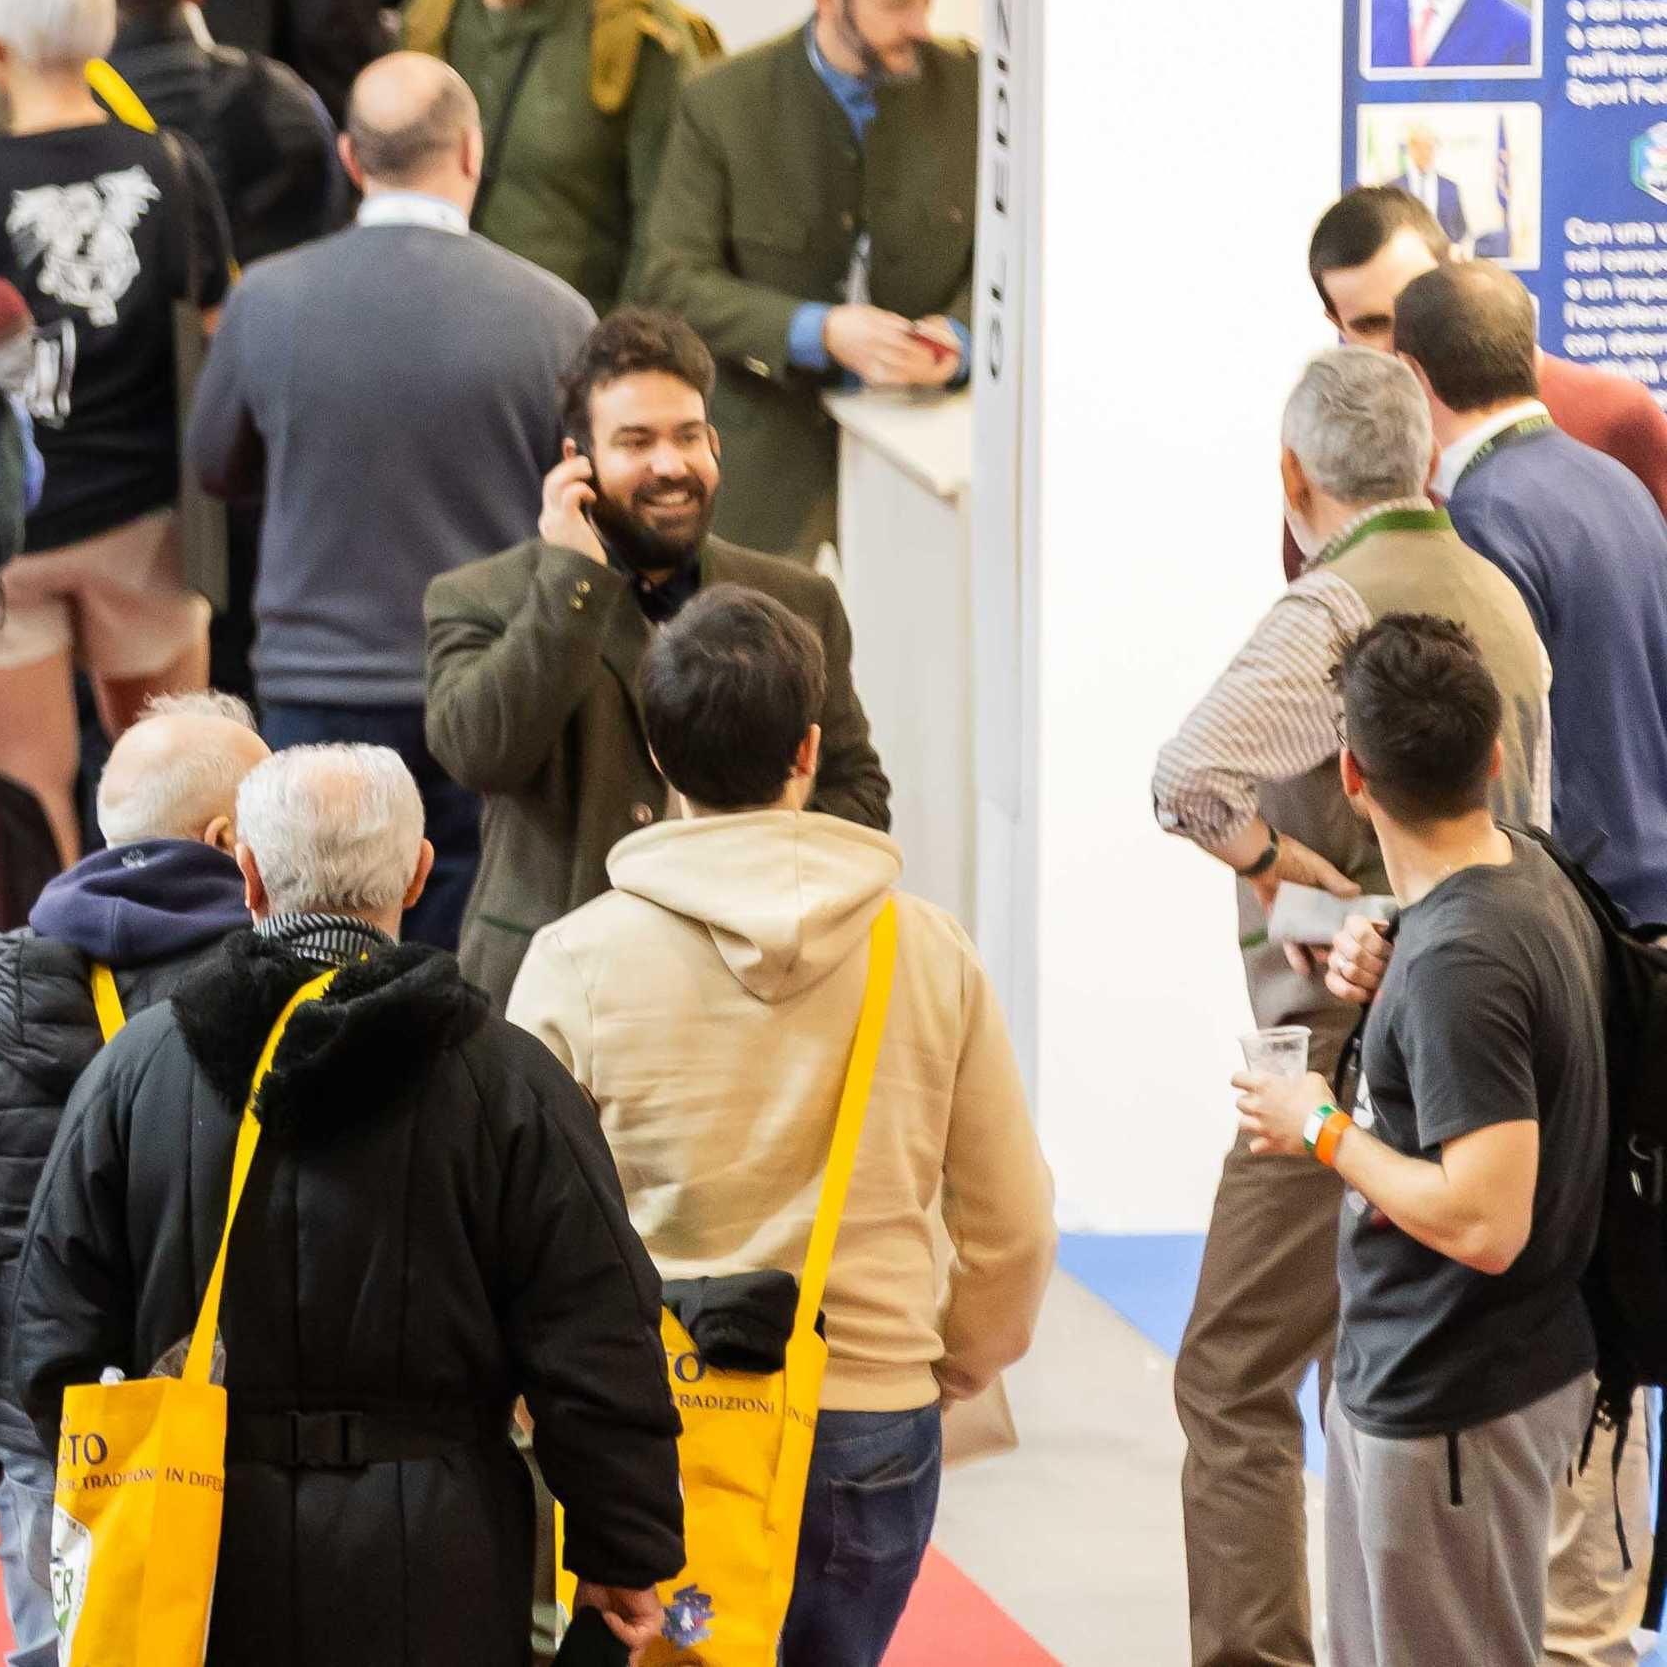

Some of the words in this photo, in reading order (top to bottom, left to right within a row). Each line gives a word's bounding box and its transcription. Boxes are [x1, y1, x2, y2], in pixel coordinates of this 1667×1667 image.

[987, 253, 1008, 382] GL
[675, 1393, 775, 1414] RADIZIONI
[166, 1467, 184, 1483] IN
